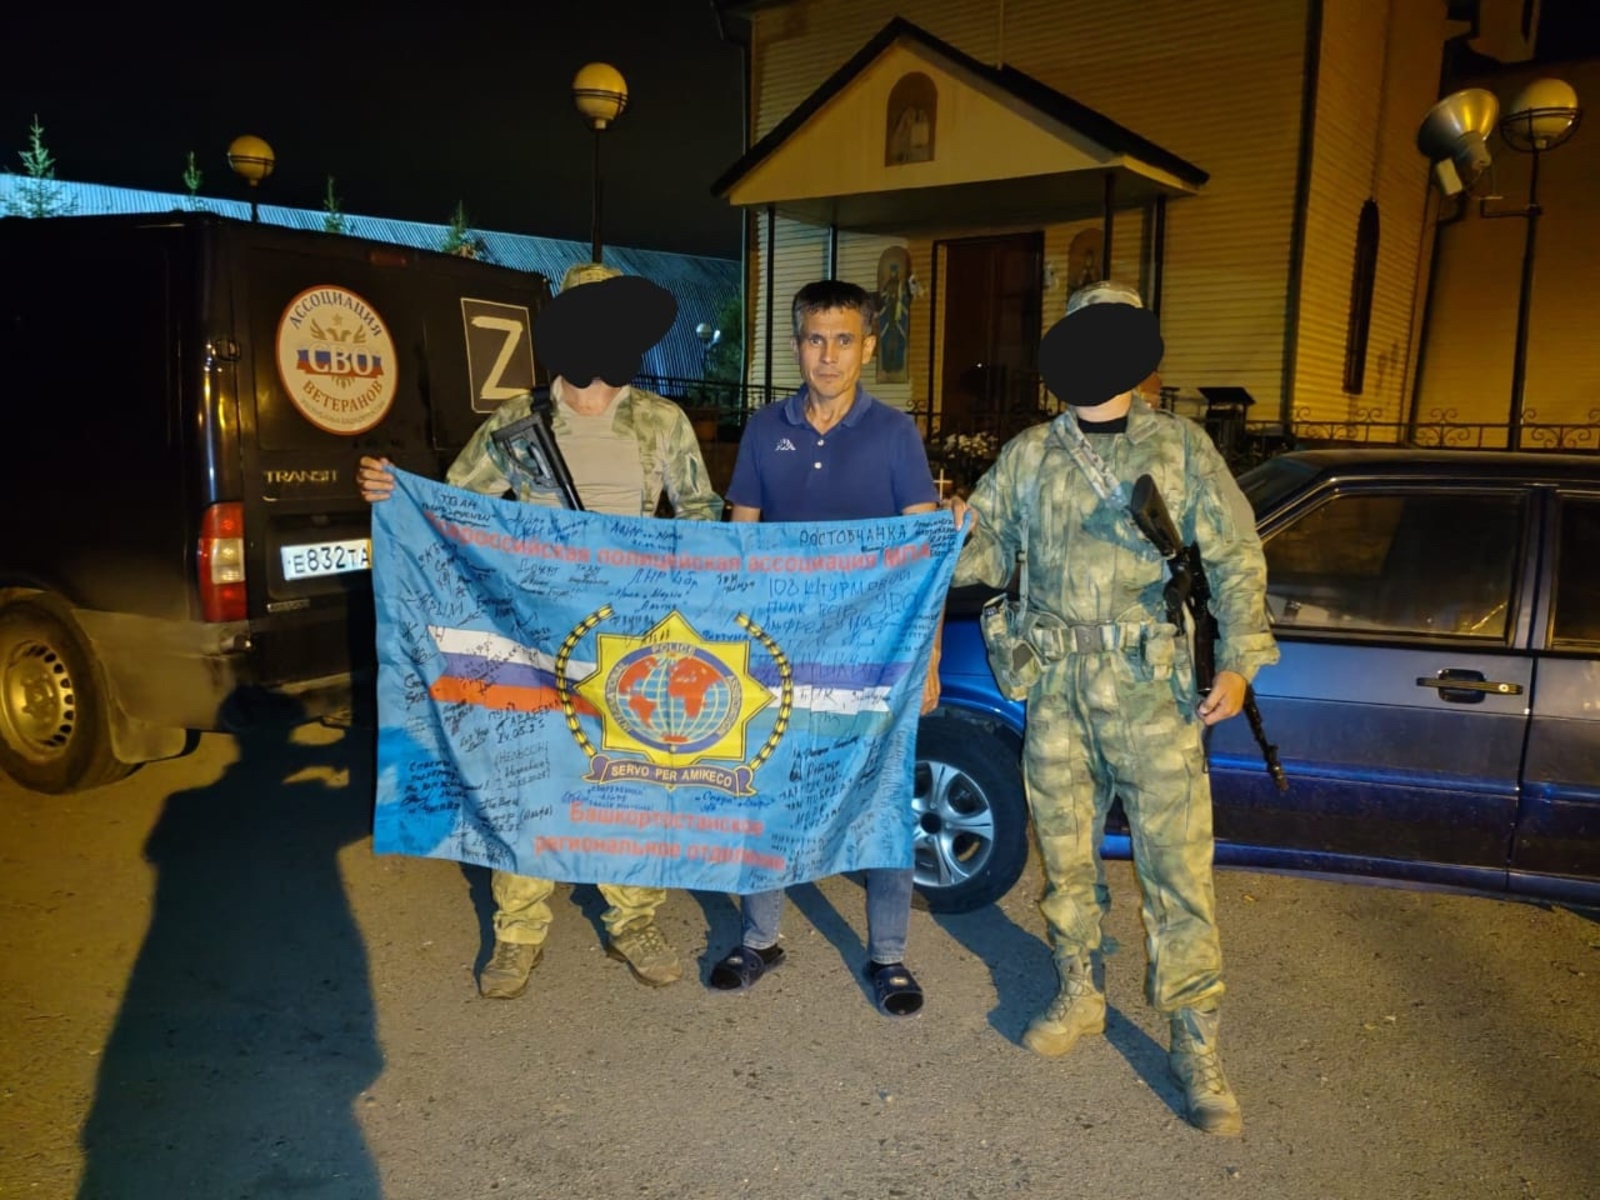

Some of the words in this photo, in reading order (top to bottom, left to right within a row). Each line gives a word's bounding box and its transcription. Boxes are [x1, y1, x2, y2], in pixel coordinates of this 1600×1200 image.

[289, 291, 382, 337] АССОЦИАЦИЯ
[308, 342, 373, 376] СВО
[472, 316, 531, 400] Z
[303, 380, 383, 412] ВЕТЕРАНОВ
[265, 470, 338, 483] TRANSIT
[748, 552, 878, 573] ассоциация
[611, 764, 650, 777] SERVO
[655, 769, 677, 781] PER
[681, 769, 733, 788] AMIKECO
